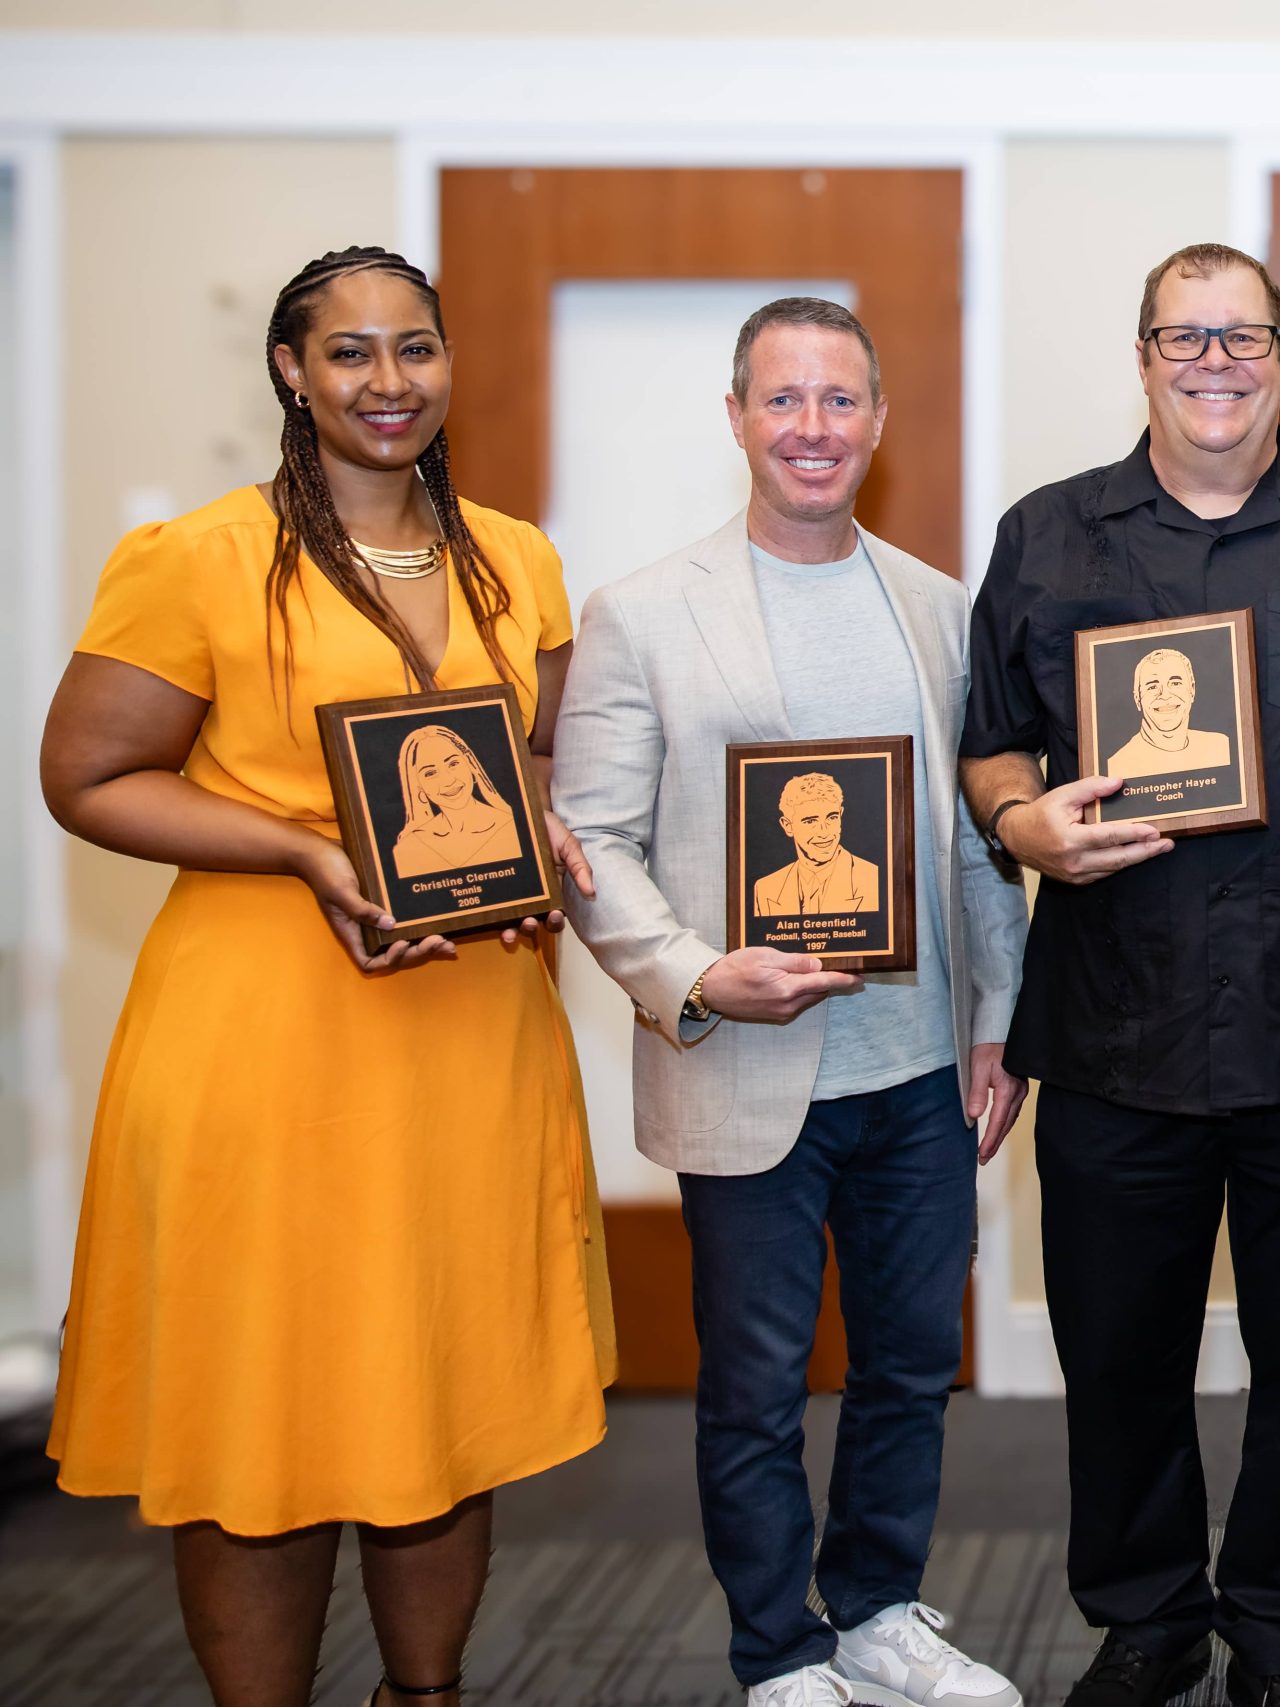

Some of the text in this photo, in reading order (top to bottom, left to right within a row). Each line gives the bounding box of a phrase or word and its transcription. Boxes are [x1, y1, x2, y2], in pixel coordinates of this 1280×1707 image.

[1122, 777, 1217, 797] Christopher Hayes
[1156, 792, 1183, 802] Coach
[412, 867, 516, 892] Christine Clermont
[451, 885, 482, 897] Tennis
[776, 918, 857, 930] Alan Greenfield
[766, 930, 867, 942] Football, Soccer, Baseball
[806, 941, 827, 950] 1997
